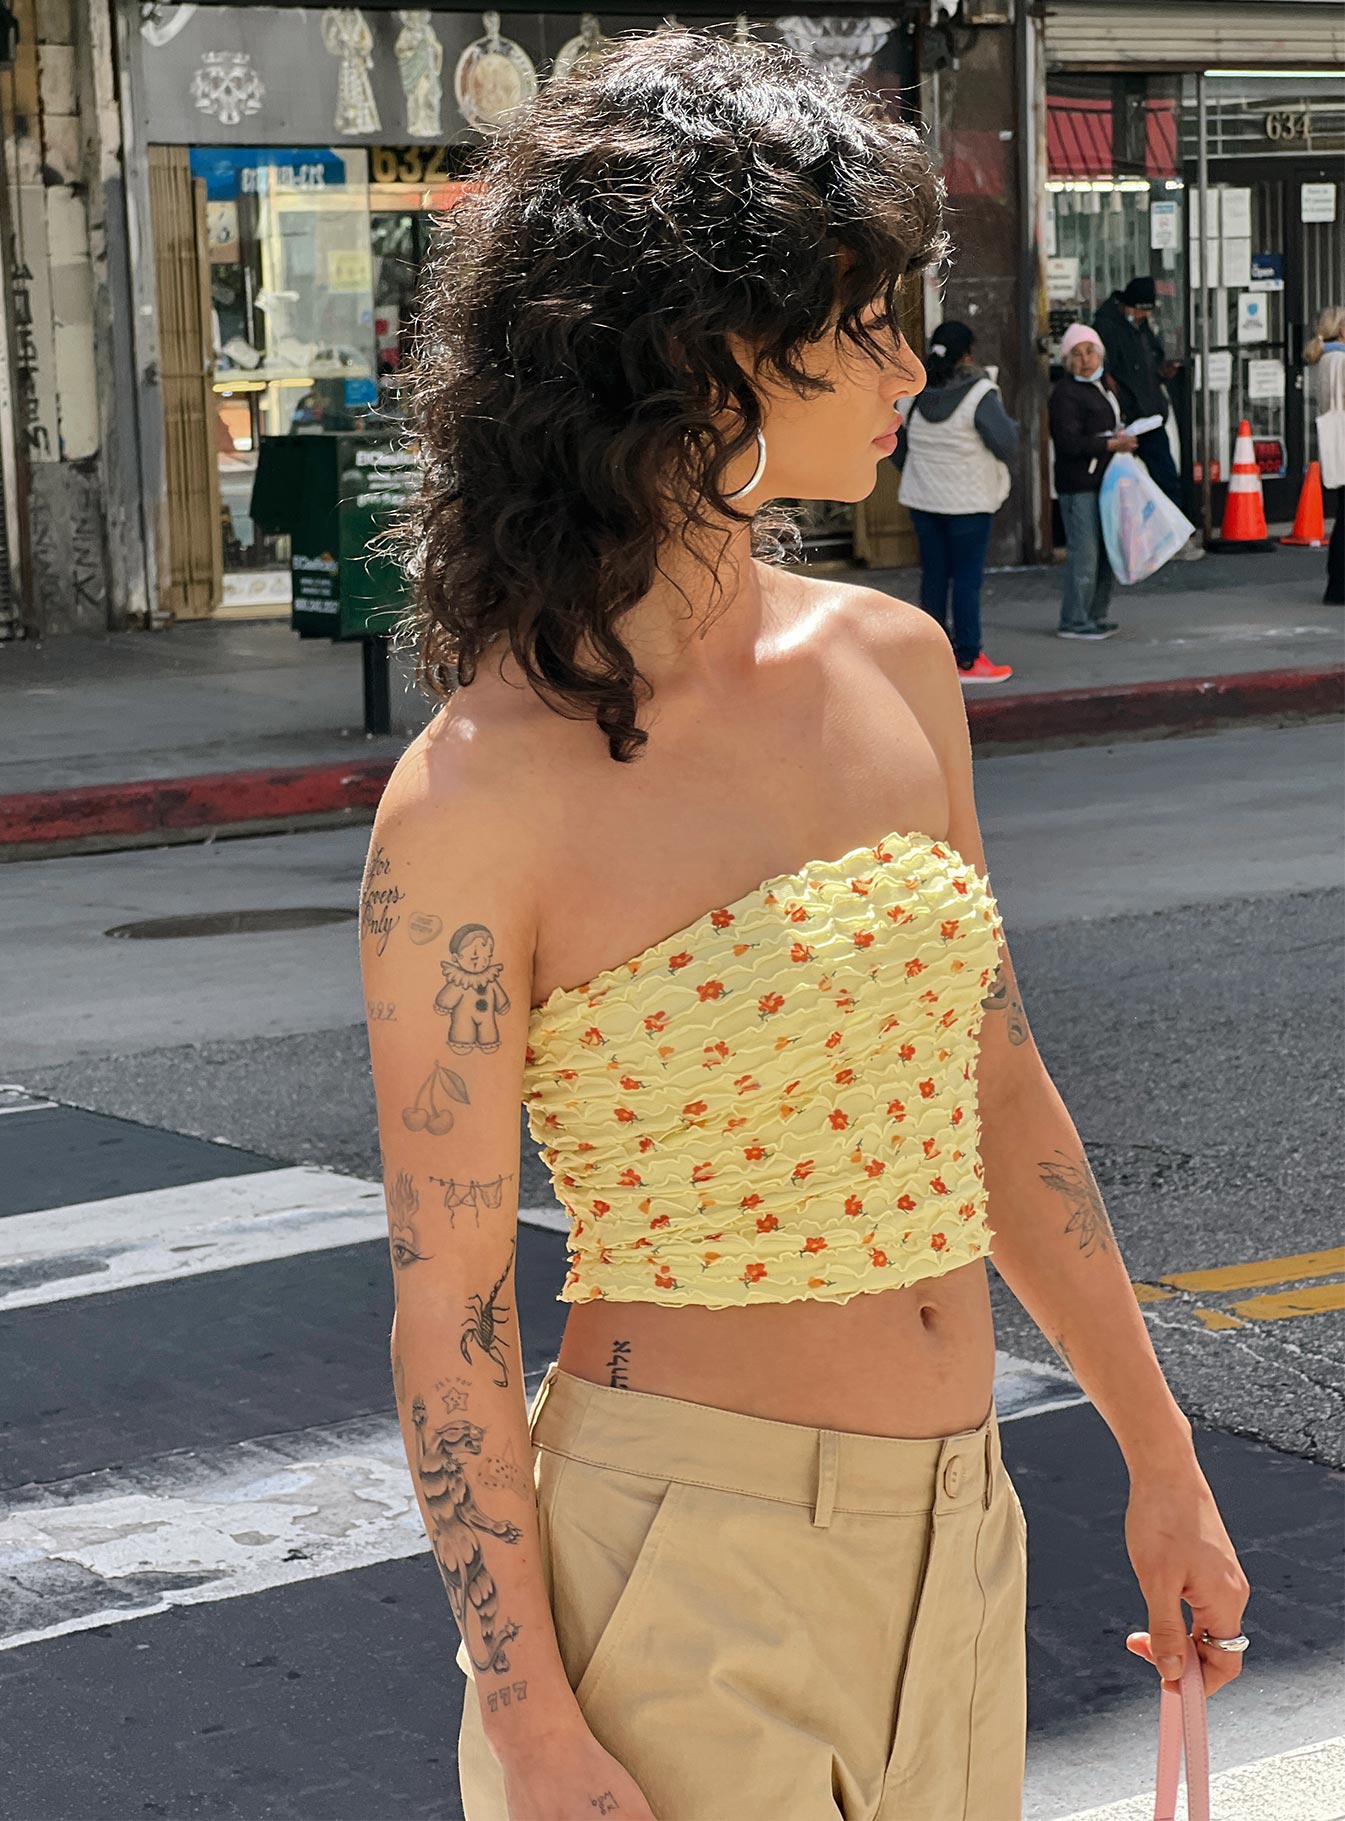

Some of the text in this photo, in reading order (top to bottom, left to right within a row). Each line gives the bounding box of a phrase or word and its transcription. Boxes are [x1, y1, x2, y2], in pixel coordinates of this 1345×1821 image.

[371, 146, 449, 183] 632
[360, 904, 401, 957] Only
[487, 1680, 528, 1712] 777
